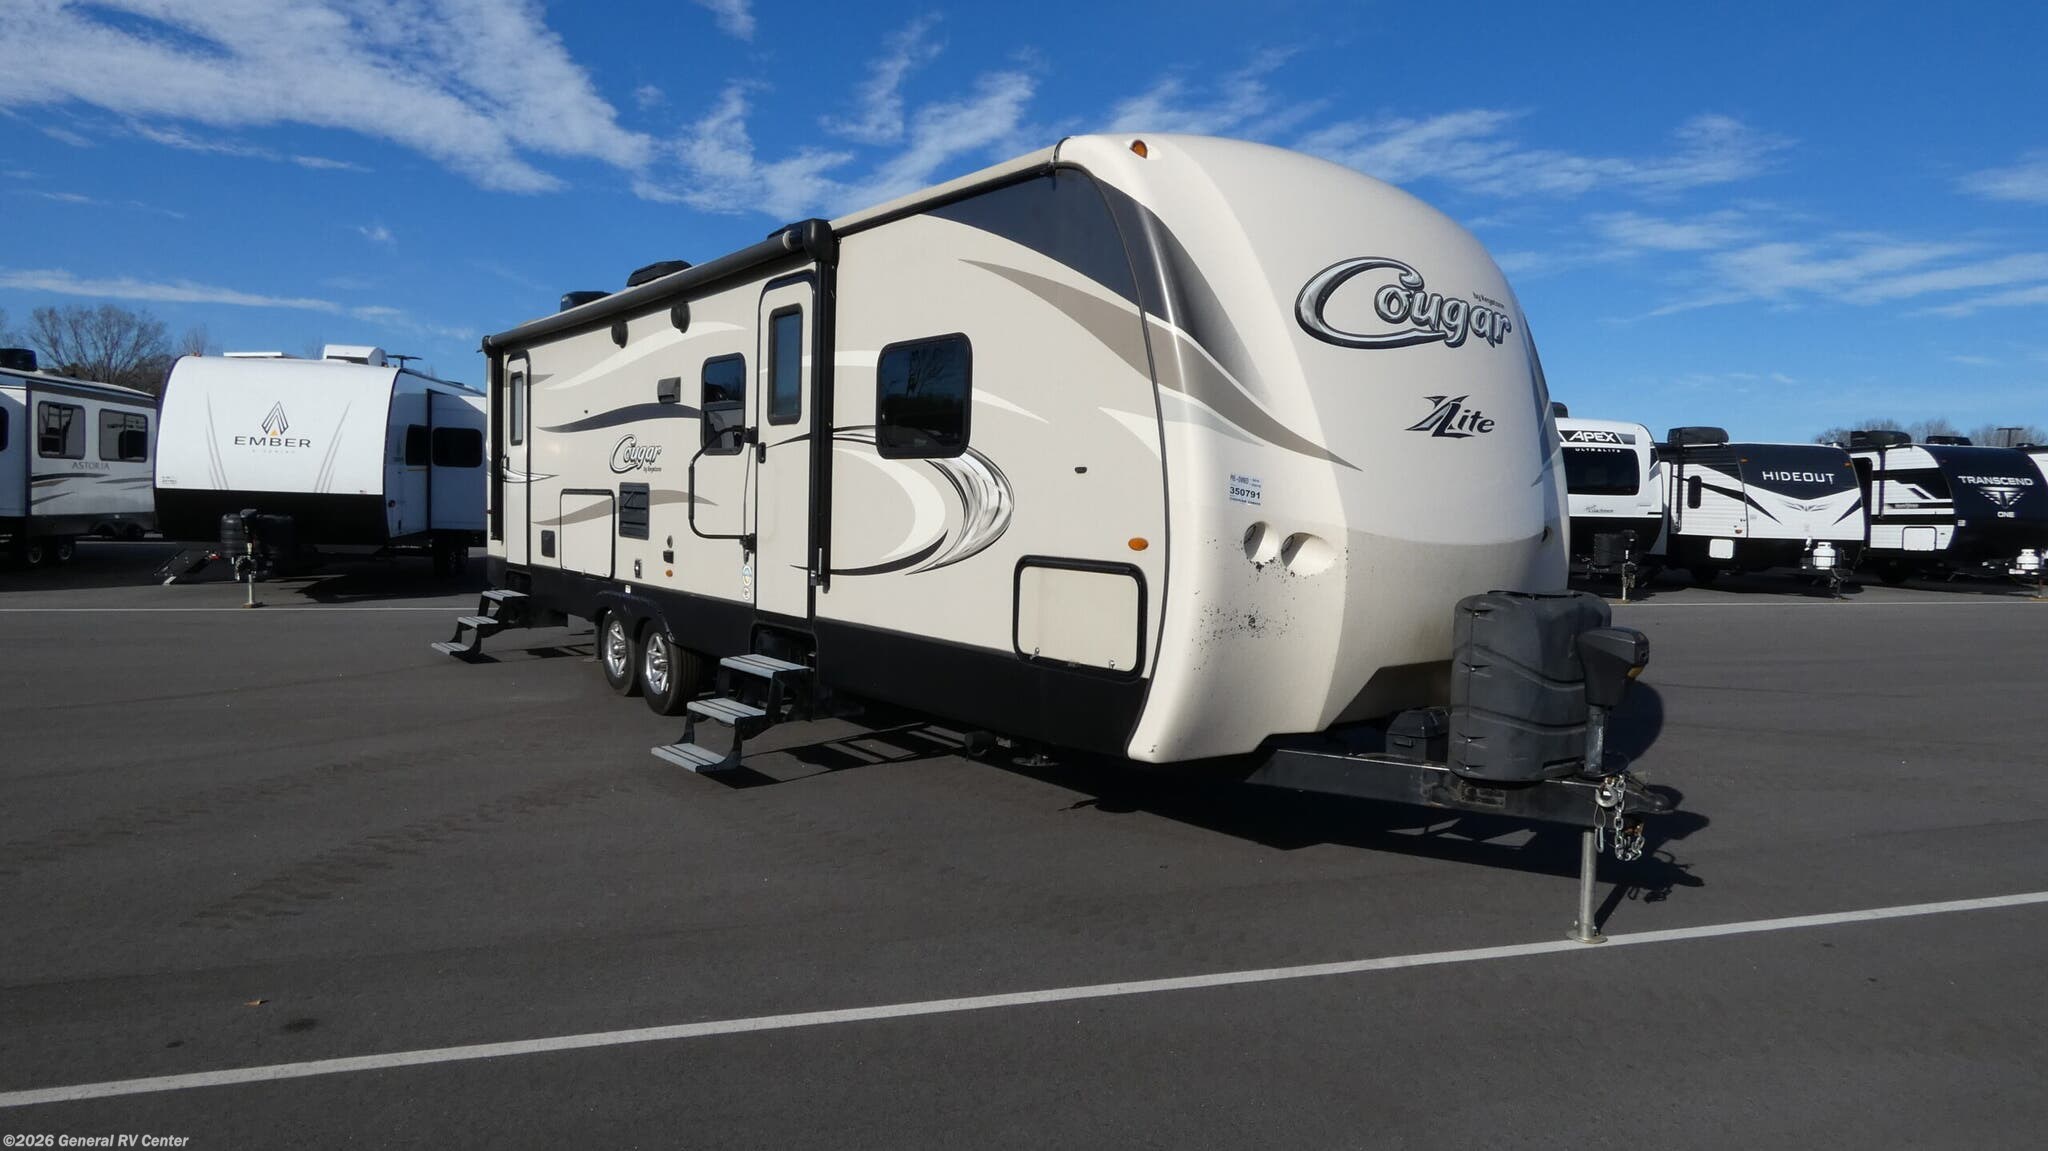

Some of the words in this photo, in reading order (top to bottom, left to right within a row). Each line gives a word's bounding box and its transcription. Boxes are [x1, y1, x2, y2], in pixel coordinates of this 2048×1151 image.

[1295, 256, 1512, 350] Cougar
[234, 435, 312, 448] EMBER
[1569, 430, 1616, 443] APEX
[609, 433, 662, 474] Cougar
[71, 461, 111, 471] ASTORIA
[1762, 471, 1835, 485] HIDEOUT
[1957, 475, 2034, 486] TRANSCEND
[1229, 486, 1261, 500] 350791
